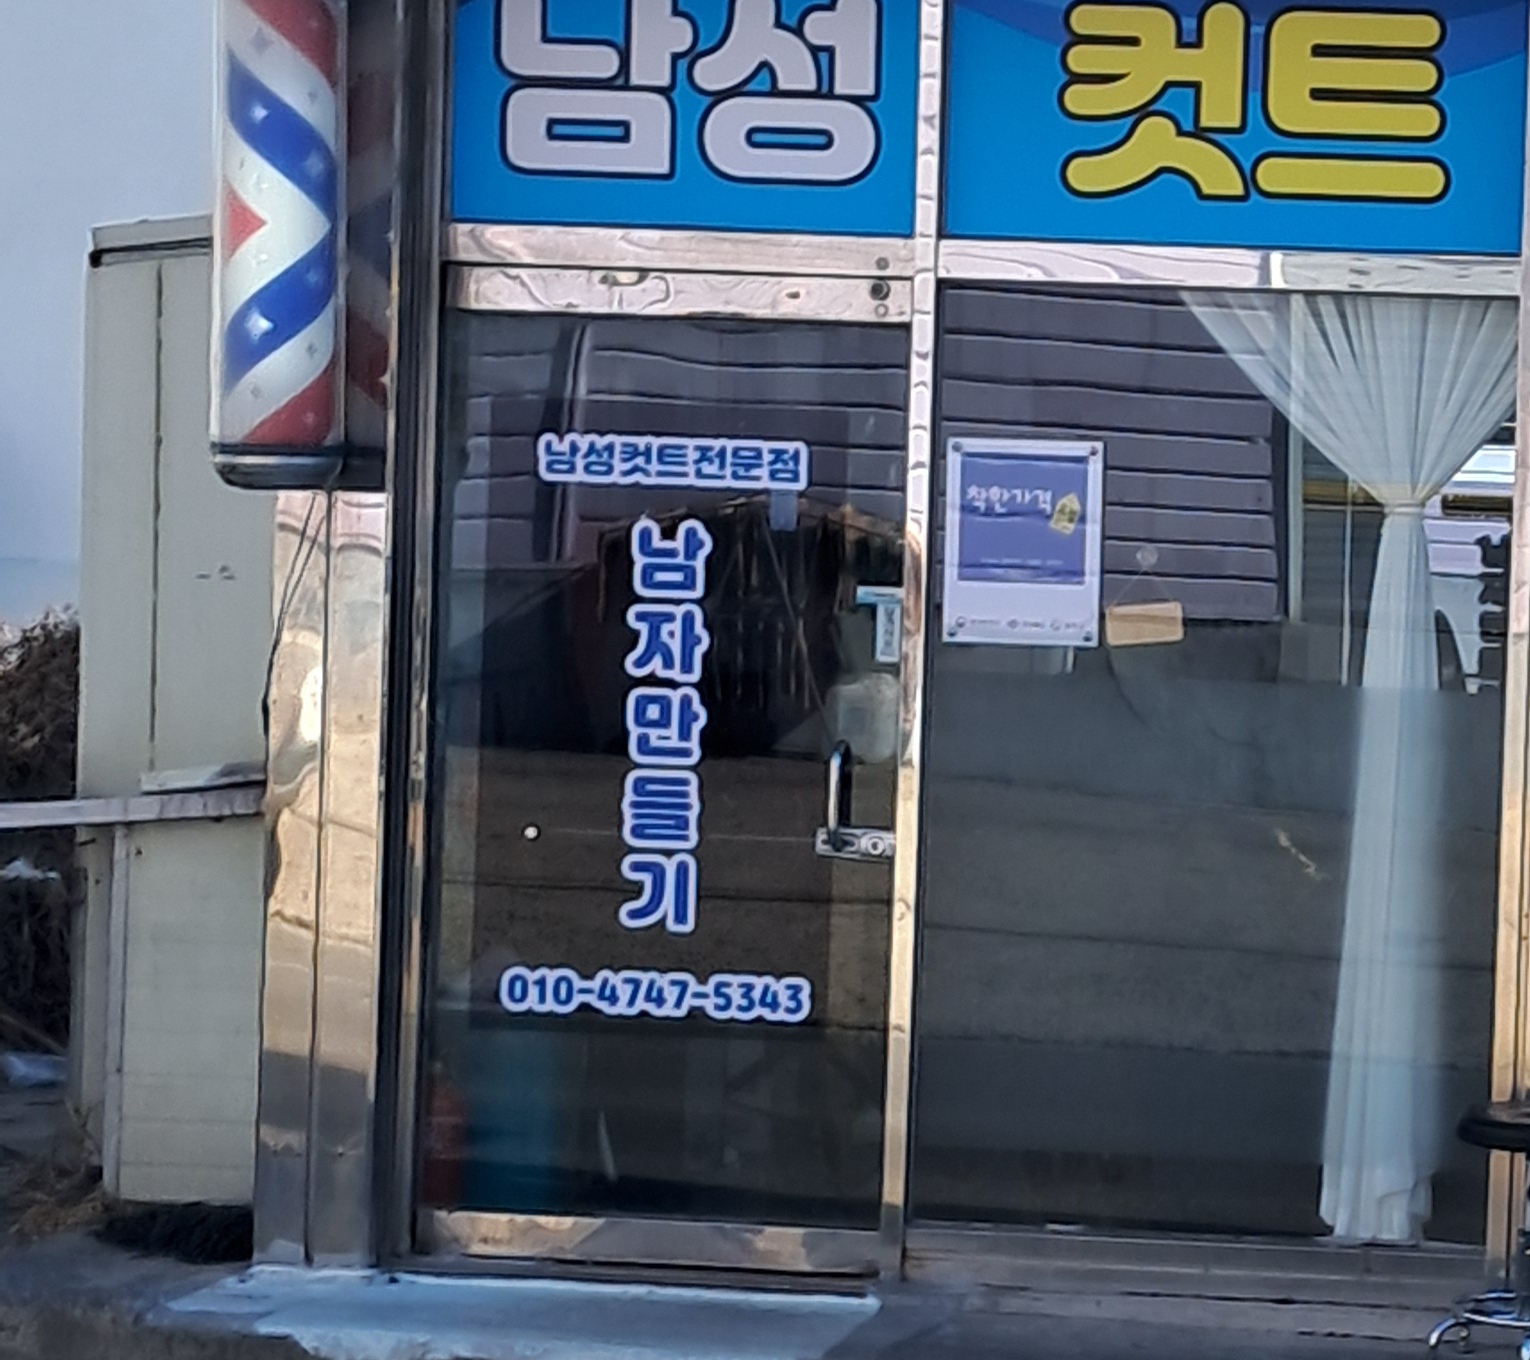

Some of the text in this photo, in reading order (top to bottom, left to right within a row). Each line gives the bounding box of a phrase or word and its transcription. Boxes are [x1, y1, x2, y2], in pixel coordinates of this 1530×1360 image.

[543, 436, 803, 485] 남성컷트전문점
[624, 521, 708, 931] 남자만들기
[505, 971, 805, 1018] 010-4747-5343
